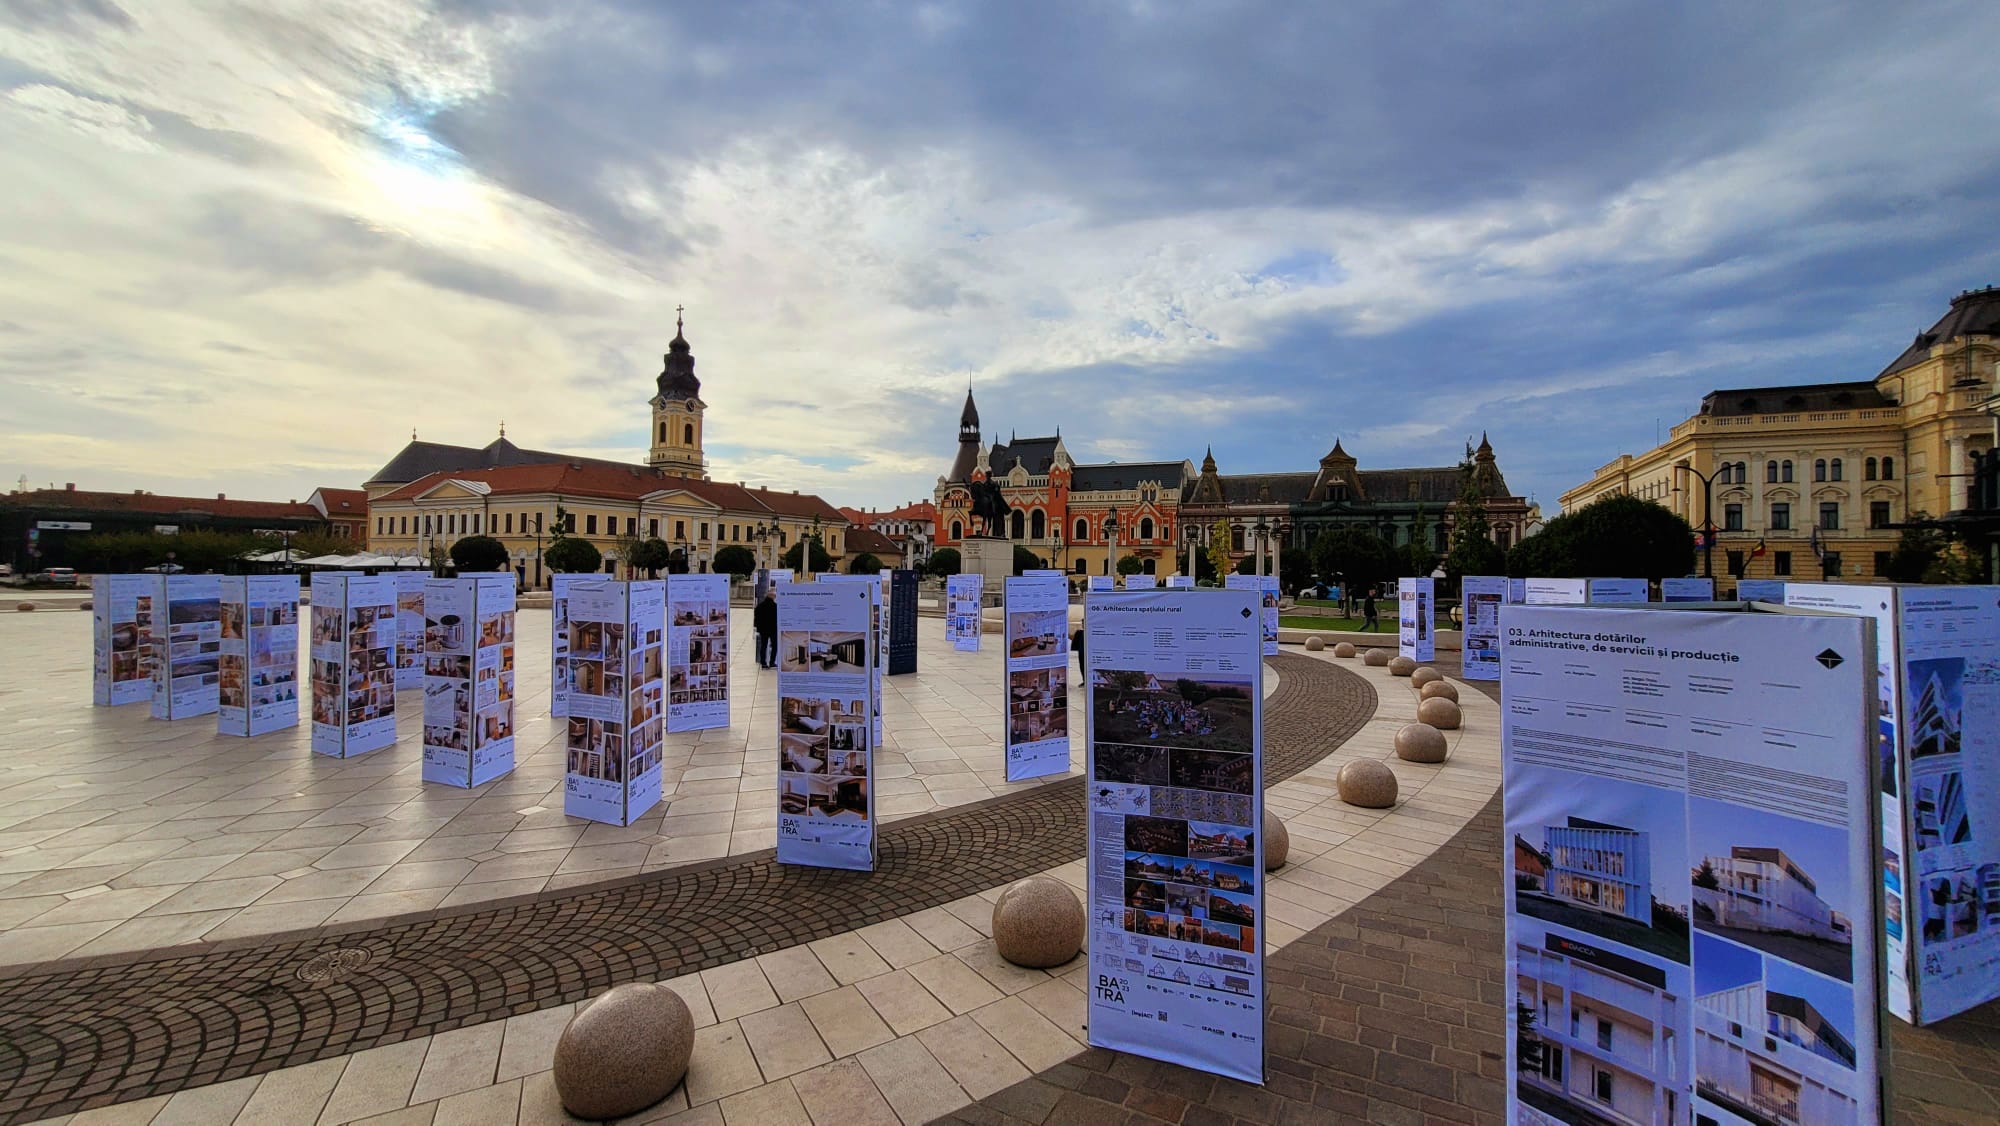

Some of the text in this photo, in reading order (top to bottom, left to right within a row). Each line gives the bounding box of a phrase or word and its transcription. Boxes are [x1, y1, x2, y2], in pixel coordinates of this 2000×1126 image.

[1103, 605, 1138, 613] Arhitectura
[1138, 606, 1166, 614] spațiului
[1166, 606, 1182, 614] rural
[1509, 627, 1647, 645] 03. Arhitectura dotărilor
[1508, 638, 1740, 665] administrative, de servicii și producție
[782, 818, 795, 827] BA
[781, 826, 798, 836] TRA
[1099, 974, 1120, 990] BA
[1095, 986, 1125, 1005] TRA
